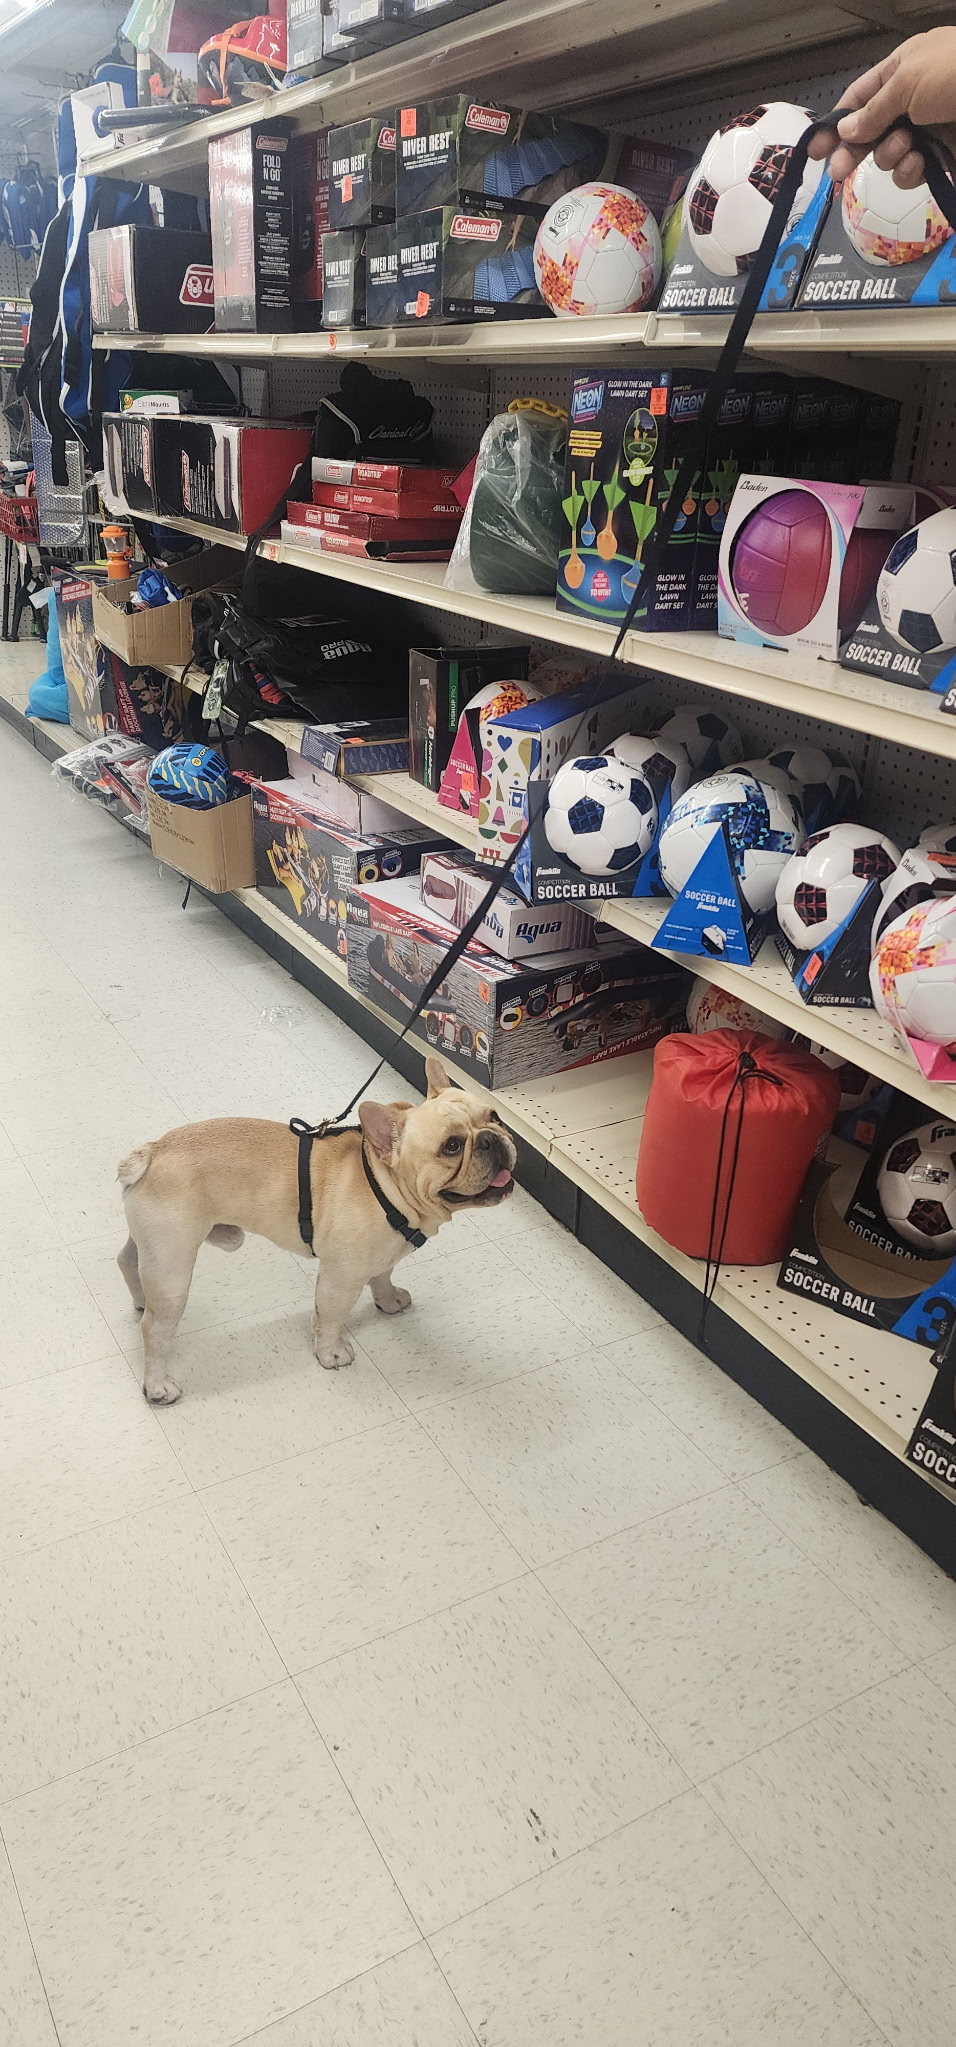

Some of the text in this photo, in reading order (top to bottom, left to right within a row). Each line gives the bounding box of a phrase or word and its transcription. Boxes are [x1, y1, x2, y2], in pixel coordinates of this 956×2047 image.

[470, 108, 500, 127] Coleman
[402, 131, 450, 157] RIVER REST
[262, 154, 281, 168] FOLD
[333, 154, 365, 176] RIVER REST
[263, 168, 281, 181] N GO
[455, 218, 490, 235] Coleman
[401, 243, 438, 265] RIVER REST
[662, 286, 736, 308] SOCCER BALL
[804, 278, 897, 301] SOCCER BALL
[608, 380, 622, 388] GLOW
[629, 380, 639, 388] THE
[575, 385, 603, 410] NEON
[673, 394, 707, 411] NEON
[357, 468, 382, 479] ROADTRIP
[740, 480, 769, 492] Baden
[658, 574, 677, 582] GLOW
[655, 583, 687, 592] THE DARK
[697, 584, 711, 592] THE
[655, 602, 684, 610] DART SET
[320, 640, 345, 652] PRO
[846, 643, 922, 676] SOCCER BALL
[127, 705, 141, 732] DOCKING
[538, 883, 619, 900] SOCCER BALL
[685, 890, 736, 908] SOCCER BALL
[346, 902, 369, 921] Aqua
[515, 921, 562, 944] Aqua
[812, 996, 839, 1004] SOCCER
[590, 1025, 662, 1062] INFLATABLE LAKE RAFT
[848, 1220, 893, 1253] SOCCER
[784, 1268, 876, 1318] SOCCER BALL
